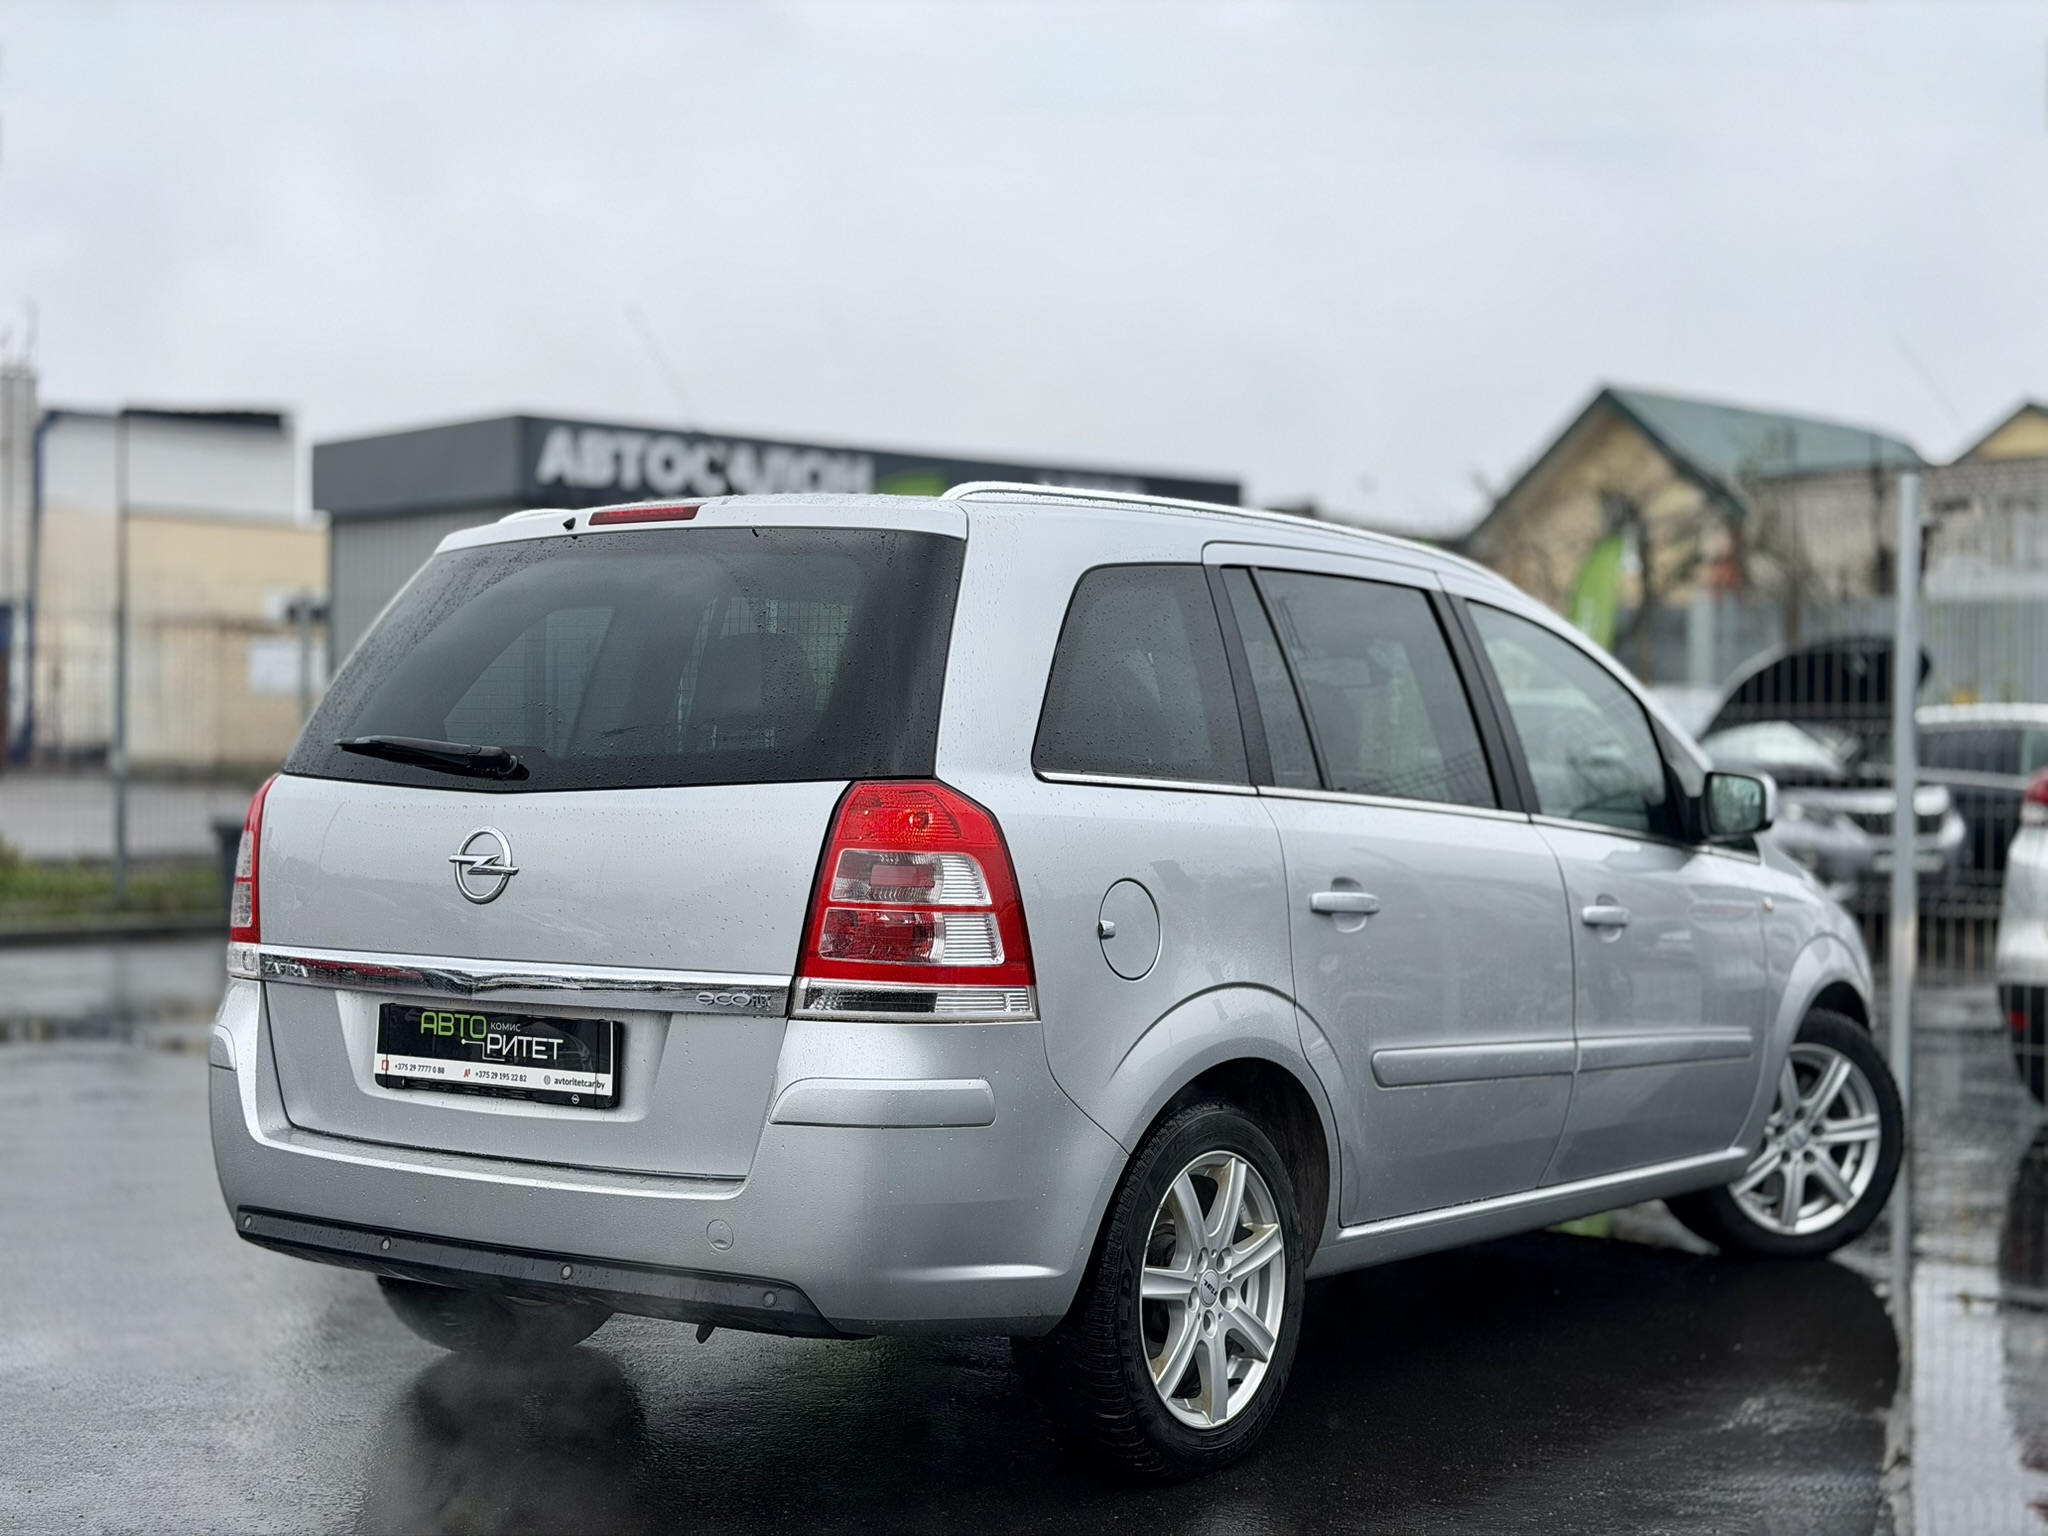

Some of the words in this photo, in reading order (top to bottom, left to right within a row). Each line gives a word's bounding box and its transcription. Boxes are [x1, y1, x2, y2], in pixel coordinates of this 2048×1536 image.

[535, 424, 876, 497] АВТОСАЛОН
[265, 961, 309, 978] ZAFIRA
[420, 1011, 487, 1039] АВТО
[490, 1022, 521, 1032] КОМИС
[486, 1033, 564, 1060] РИТЕТ
[394, 1063, 408, 1071] +375
[409, 1064, 417, 1072] 29
[417, 1064, 432, 1073] 7777
[475, 1070, 490, 1079] +375
[490, 1071, 498, 1080] 29
[510, 1073, 519, 1082] 22
[554, 1077, 605, 1090] avtoritetcarby
